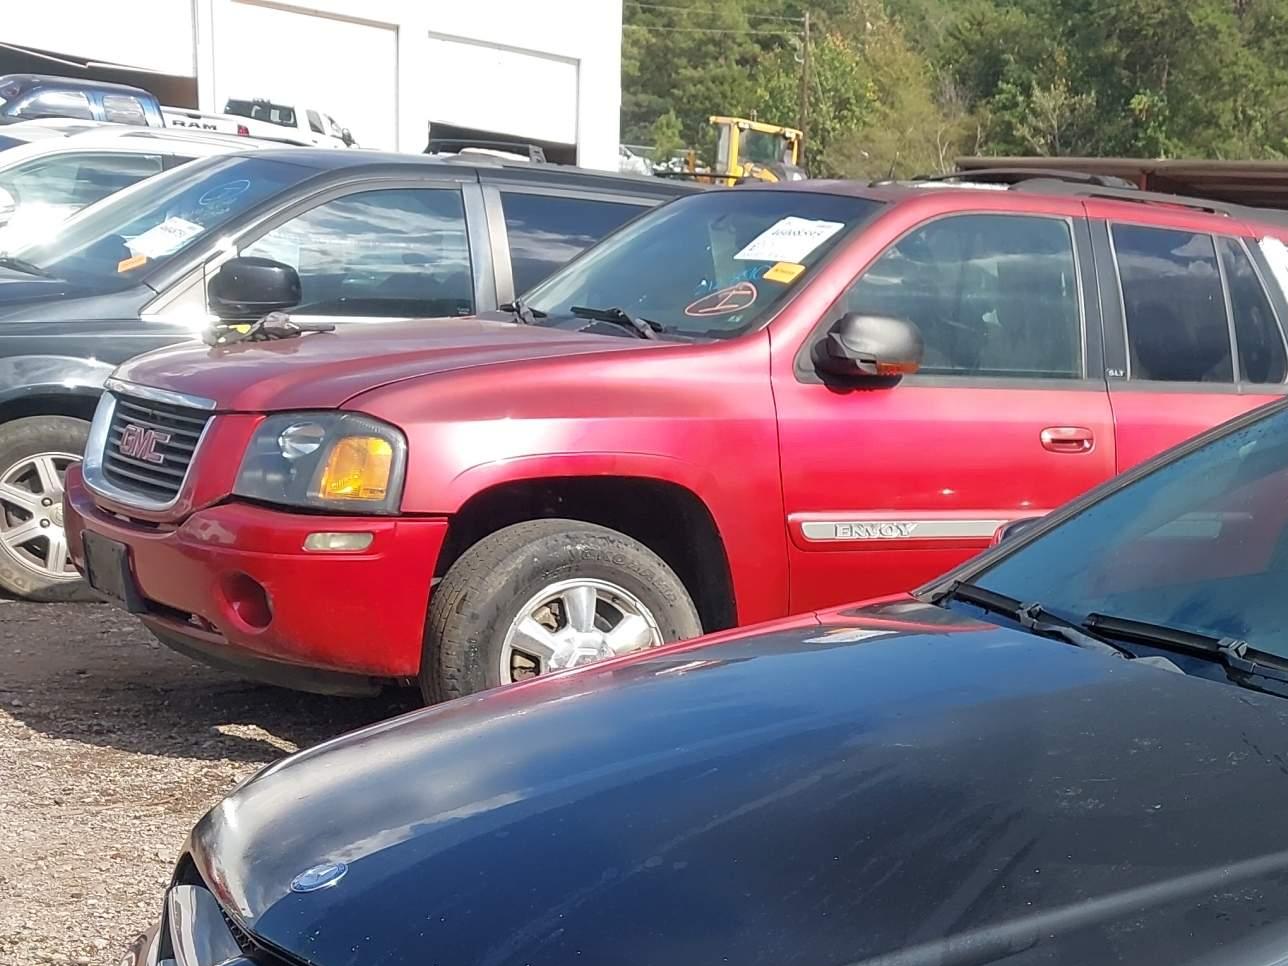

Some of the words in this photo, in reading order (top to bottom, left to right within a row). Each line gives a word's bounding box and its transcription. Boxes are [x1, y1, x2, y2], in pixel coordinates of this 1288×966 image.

[172, 119, 217, 131] RAM
[120, 423, 172, 464] GMC
[834, 522, 918, 539] ENVOY
